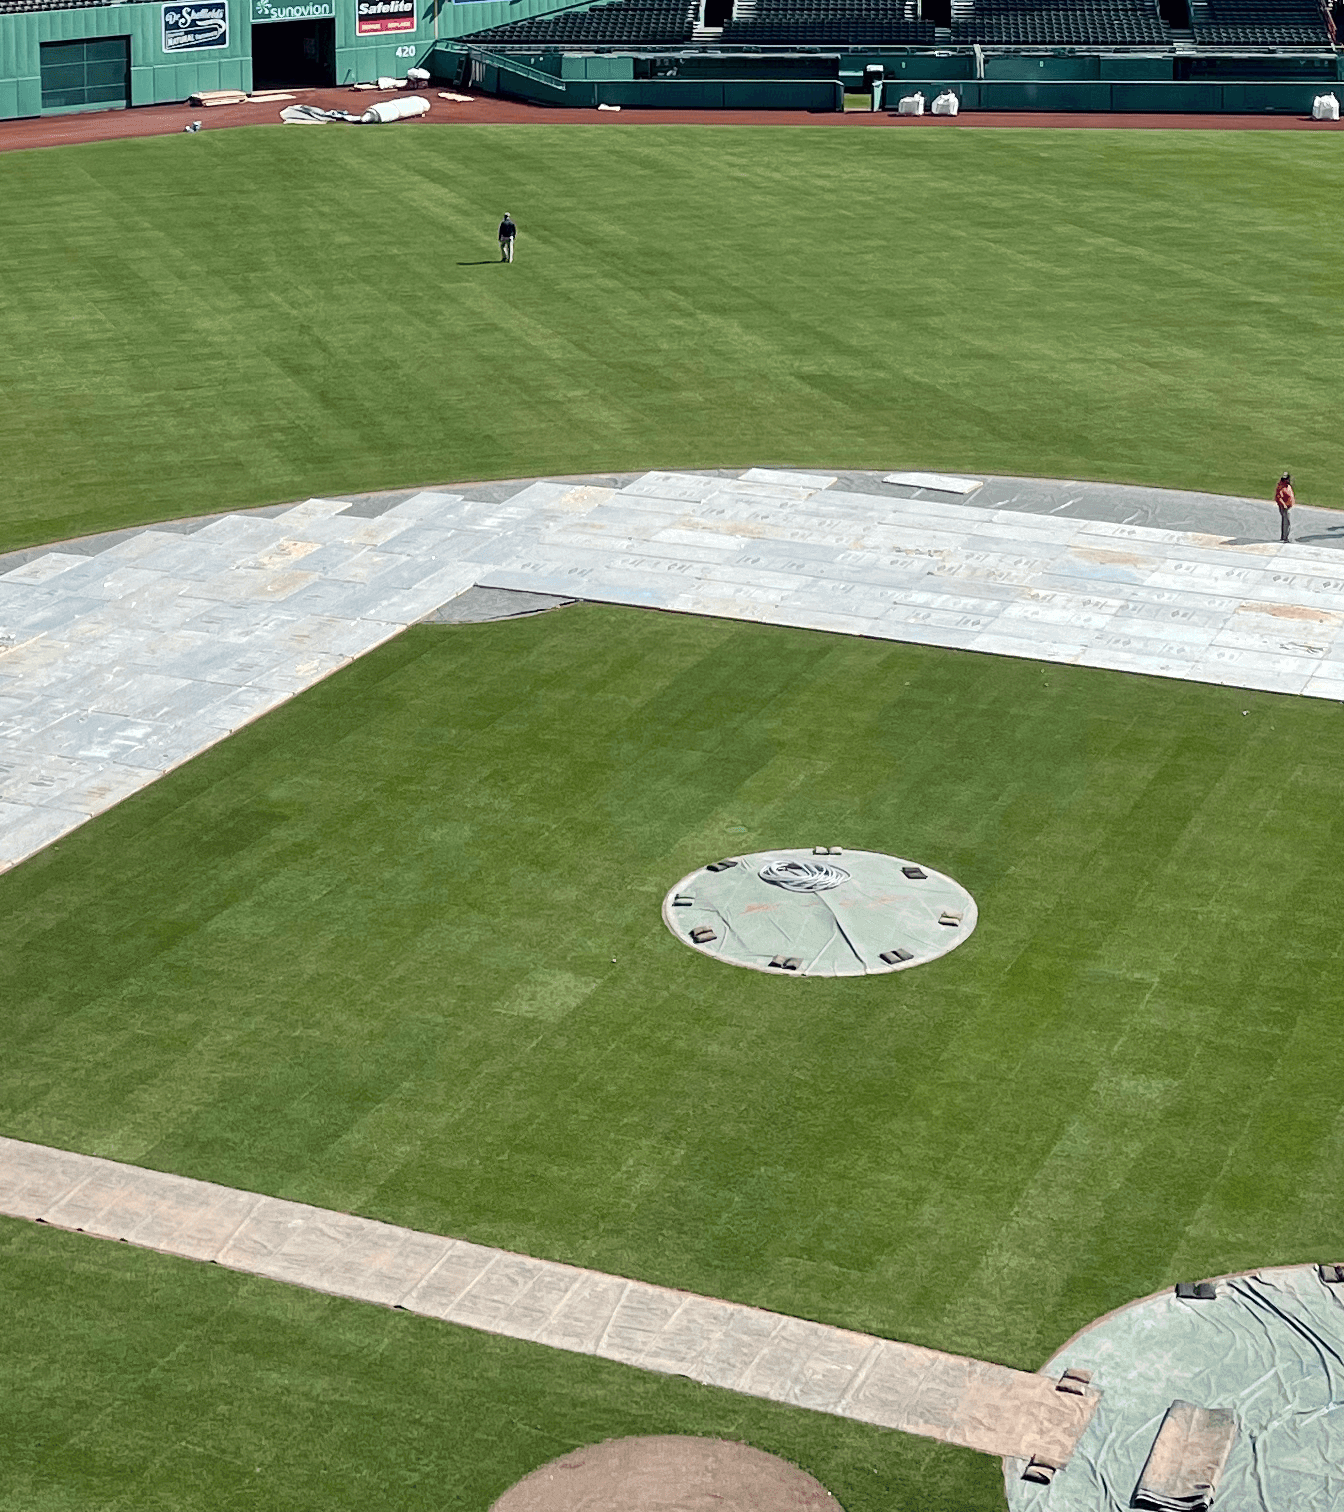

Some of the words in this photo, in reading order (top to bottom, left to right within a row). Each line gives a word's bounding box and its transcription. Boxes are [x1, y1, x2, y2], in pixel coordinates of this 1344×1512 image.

[269, 1, 330, 19] sunovion
[358, 0, 413, 15] Safelite
[395, 45, 416, 58] 420
